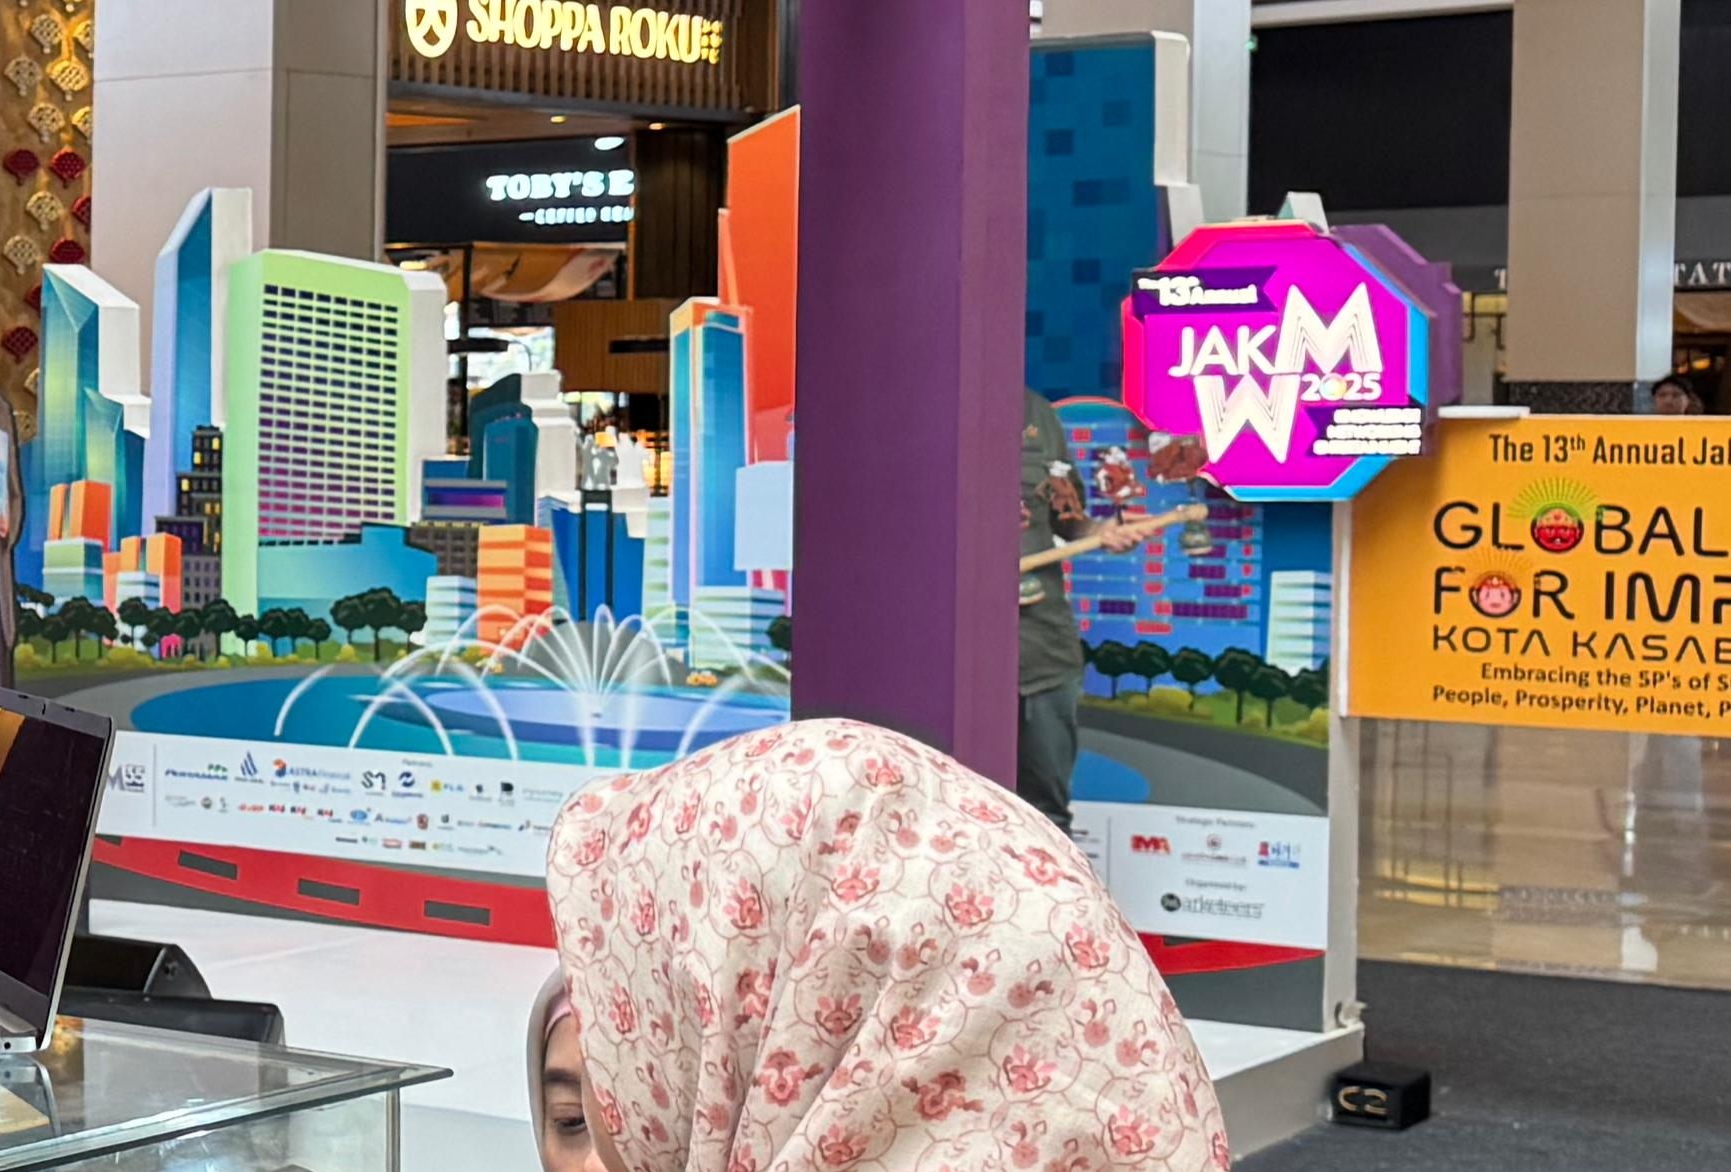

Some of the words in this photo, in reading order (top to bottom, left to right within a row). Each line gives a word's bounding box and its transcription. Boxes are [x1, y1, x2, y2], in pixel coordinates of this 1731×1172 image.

[467, 0, 605, 53] SHOPPA
[609, 6, 703, 63] ROKU
[486, 171, 605, 201] TOBY'S
[1301, 373, 1382, 401] 2025
[1488, 434, 1534, 462] The
[1542, 433, 1586, 464] 13th
[1593, 436, 1685, 466] Annual
[1433, 500, 1730, 558] GLOBAL
[1433, 565, 1575, 621] FOR
[1433, 624, 1551, 657] KOTA
[1481, 662, 1590, 688] Embracing
[1596, 668, 1632, 688] the
[1688, 673, 1711, 692] of
[1432, 684, 1509, 709] People,
[1515, 689, 1630, 715] Prosperity,
[1635, 695, 1711, 719] Planet,
